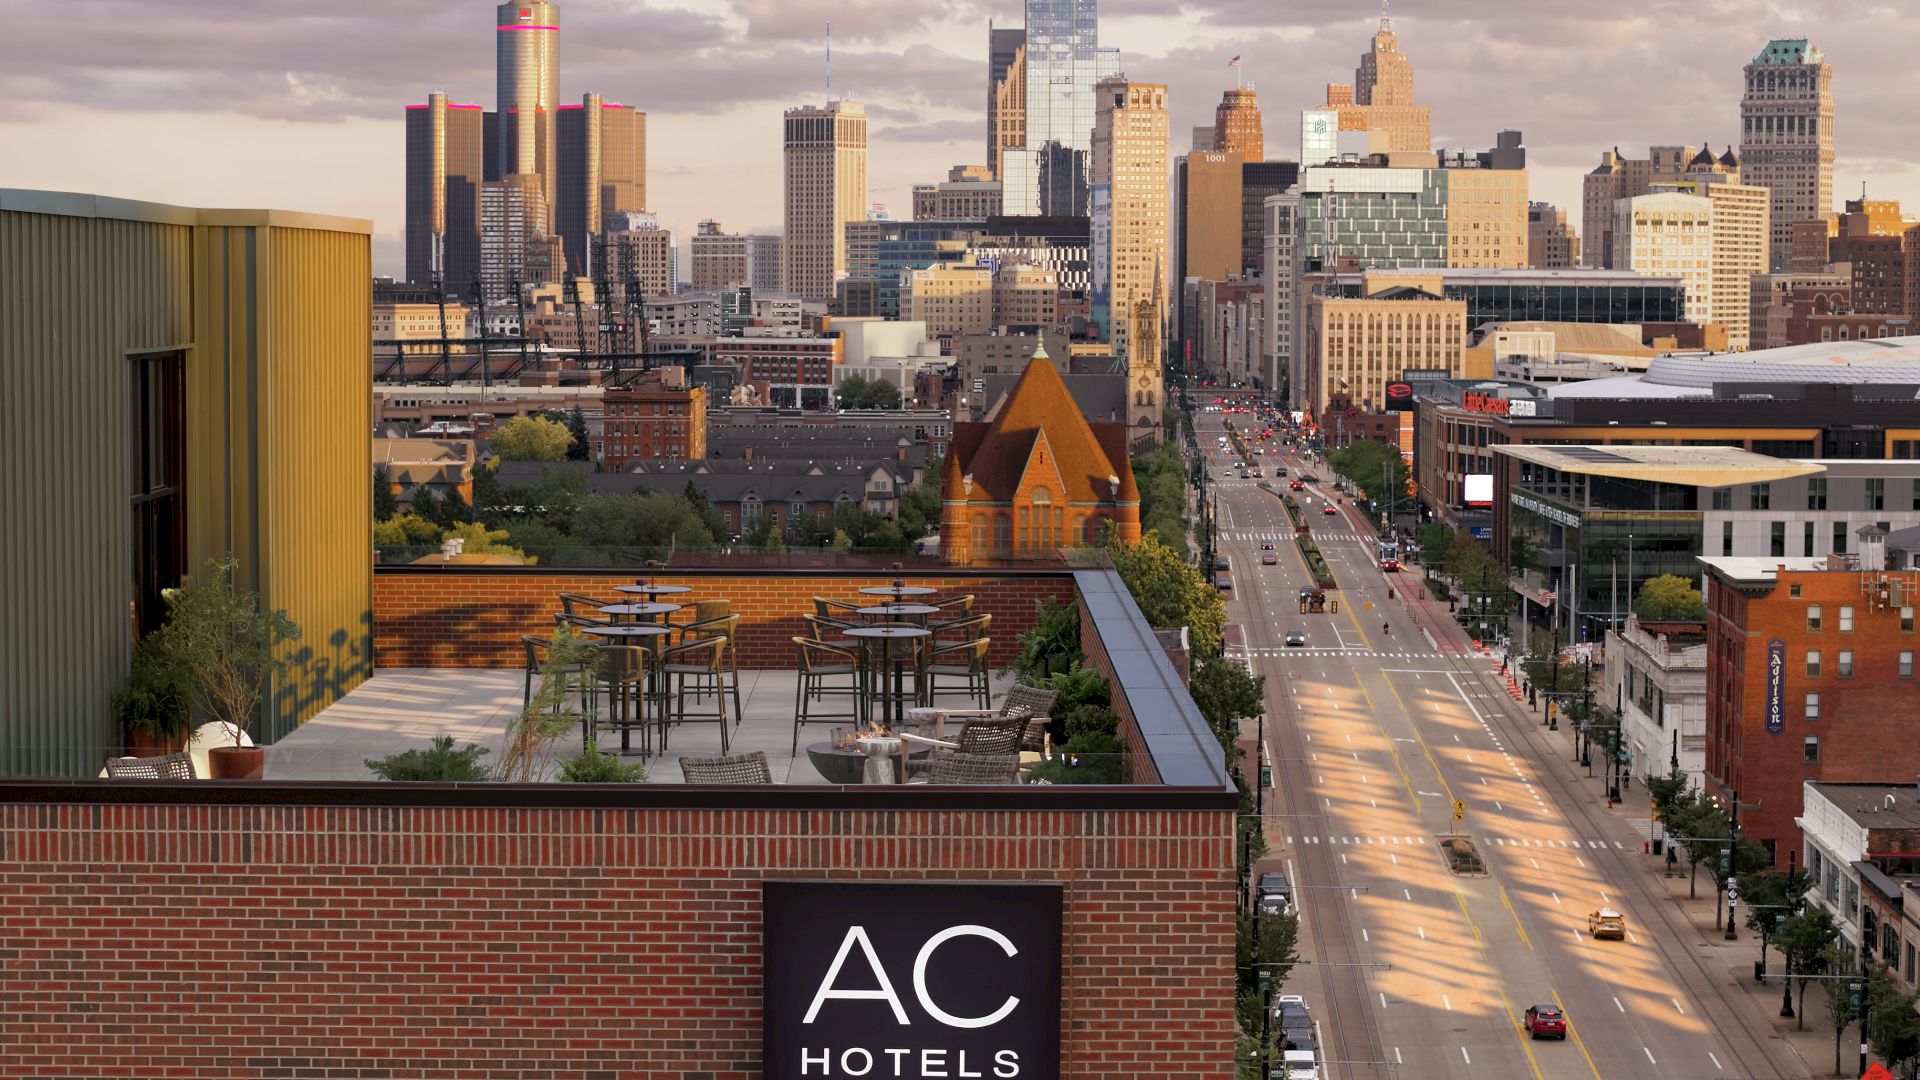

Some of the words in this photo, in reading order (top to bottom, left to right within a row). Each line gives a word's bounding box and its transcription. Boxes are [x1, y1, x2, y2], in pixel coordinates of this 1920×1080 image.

[1206, 154, 1225, 162] 1001
[802, 924, 1021, 1029] AC
[801, 1047, 1021, 1078] HOTELS
